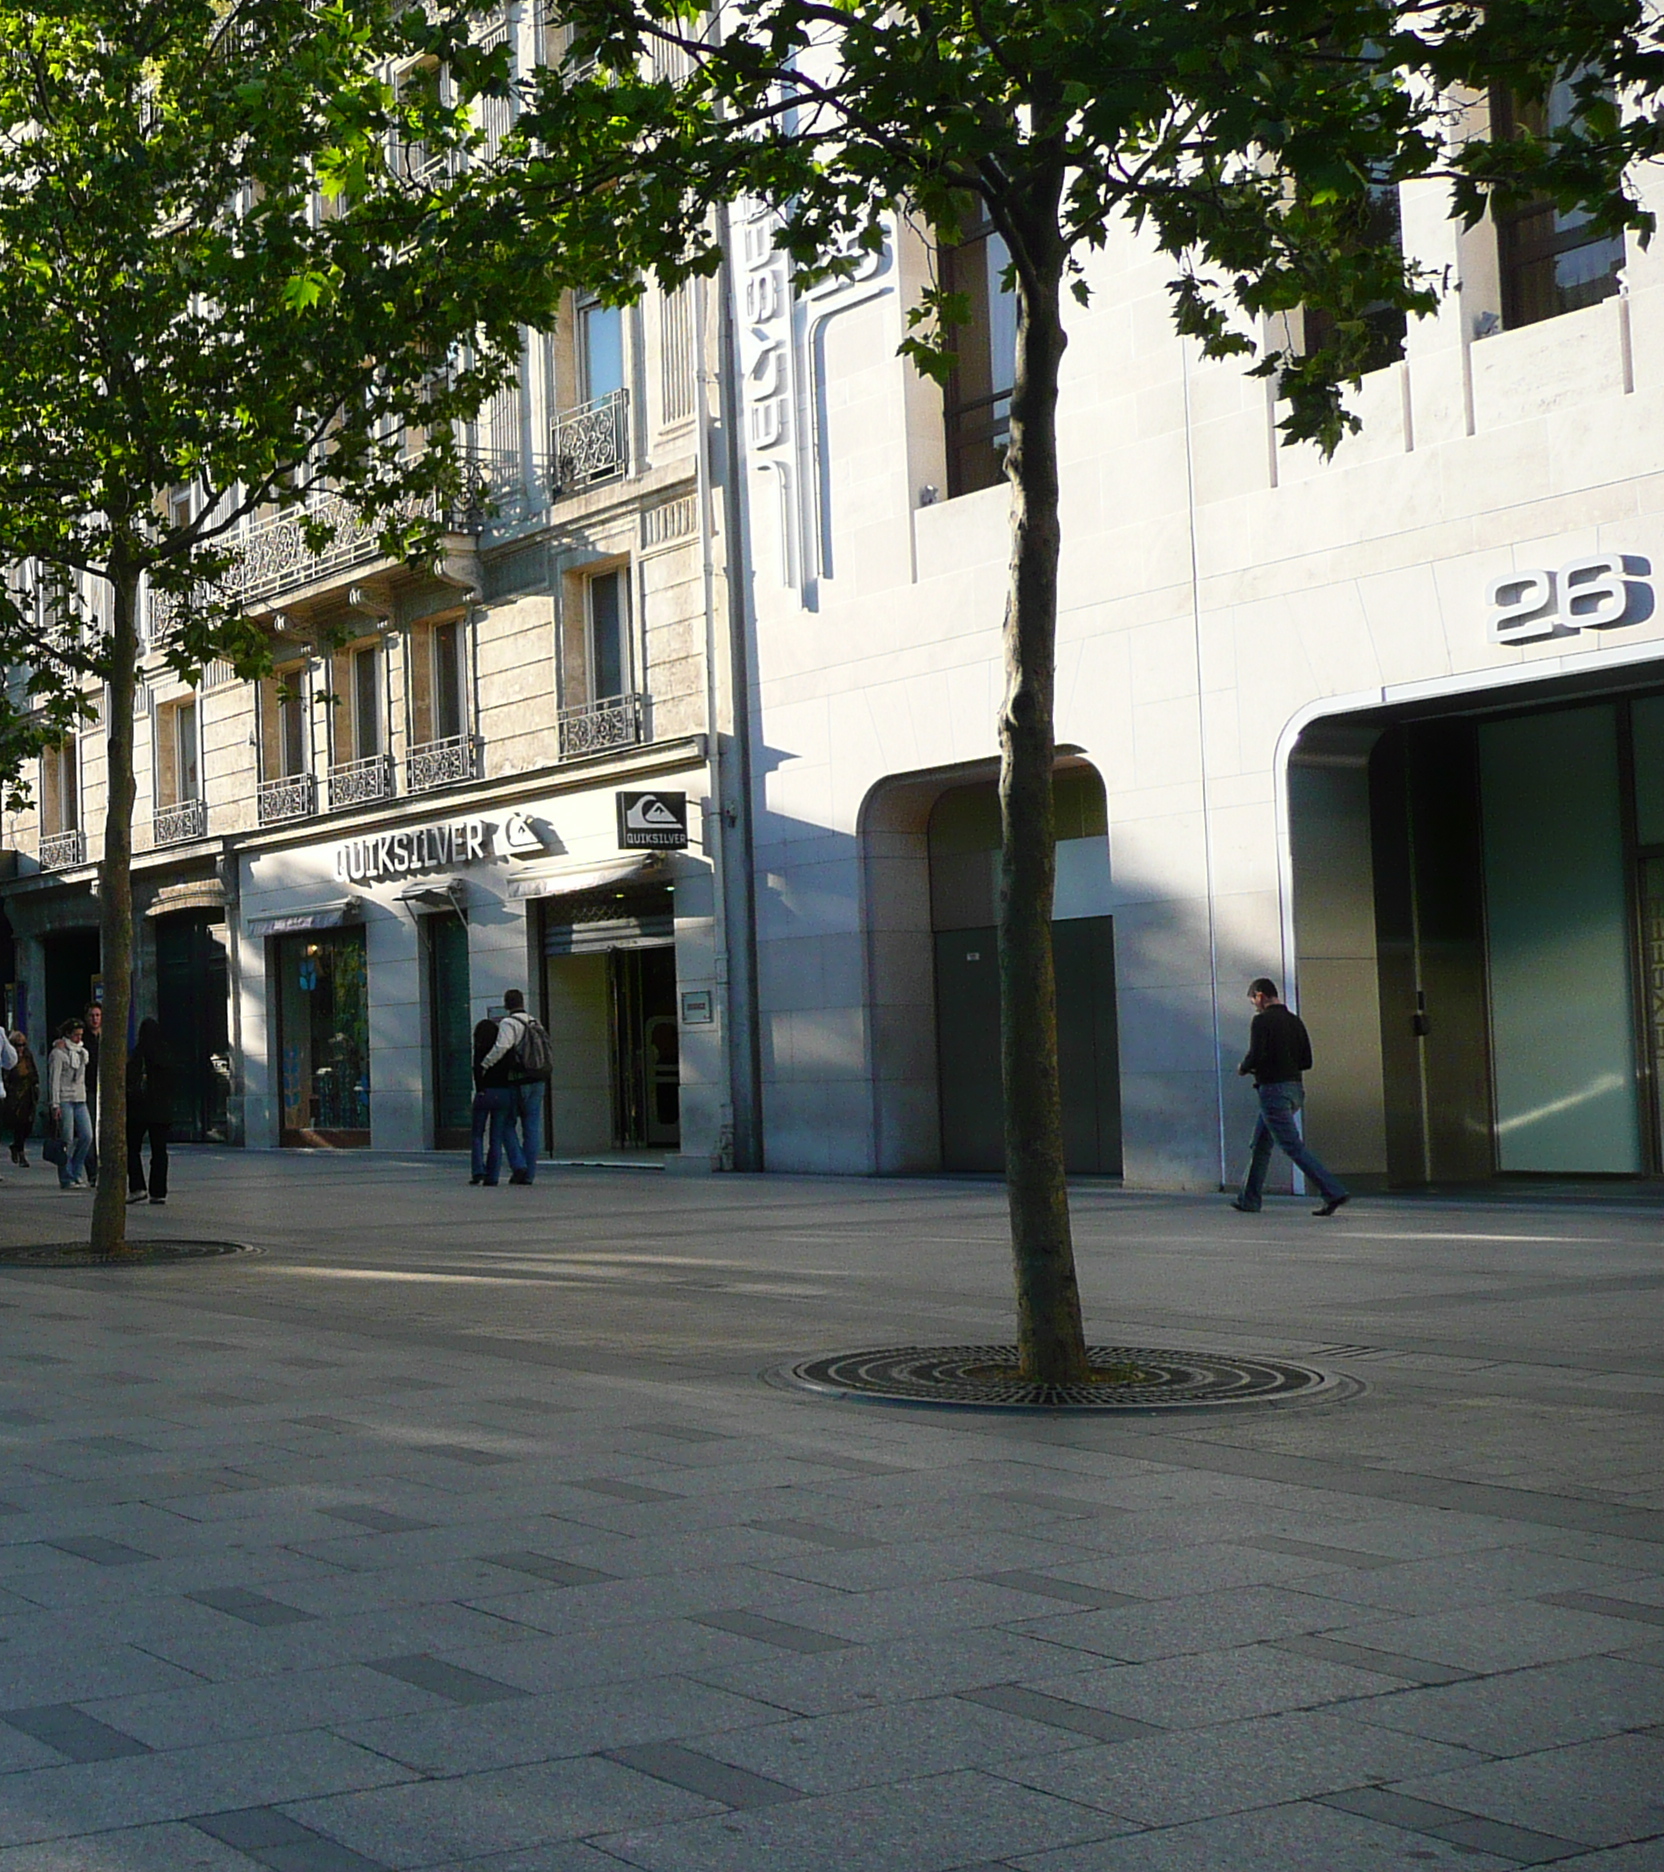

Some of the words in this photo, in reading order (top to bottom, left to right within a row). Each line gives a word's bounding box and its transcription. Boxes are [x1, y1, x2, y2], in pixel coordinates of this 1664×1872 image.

[1484, 553, 1627, 644] 26
[334, 818, 486, 883] QUIKSILVER
[626, 832, 687, 845] QUIKSILVER
